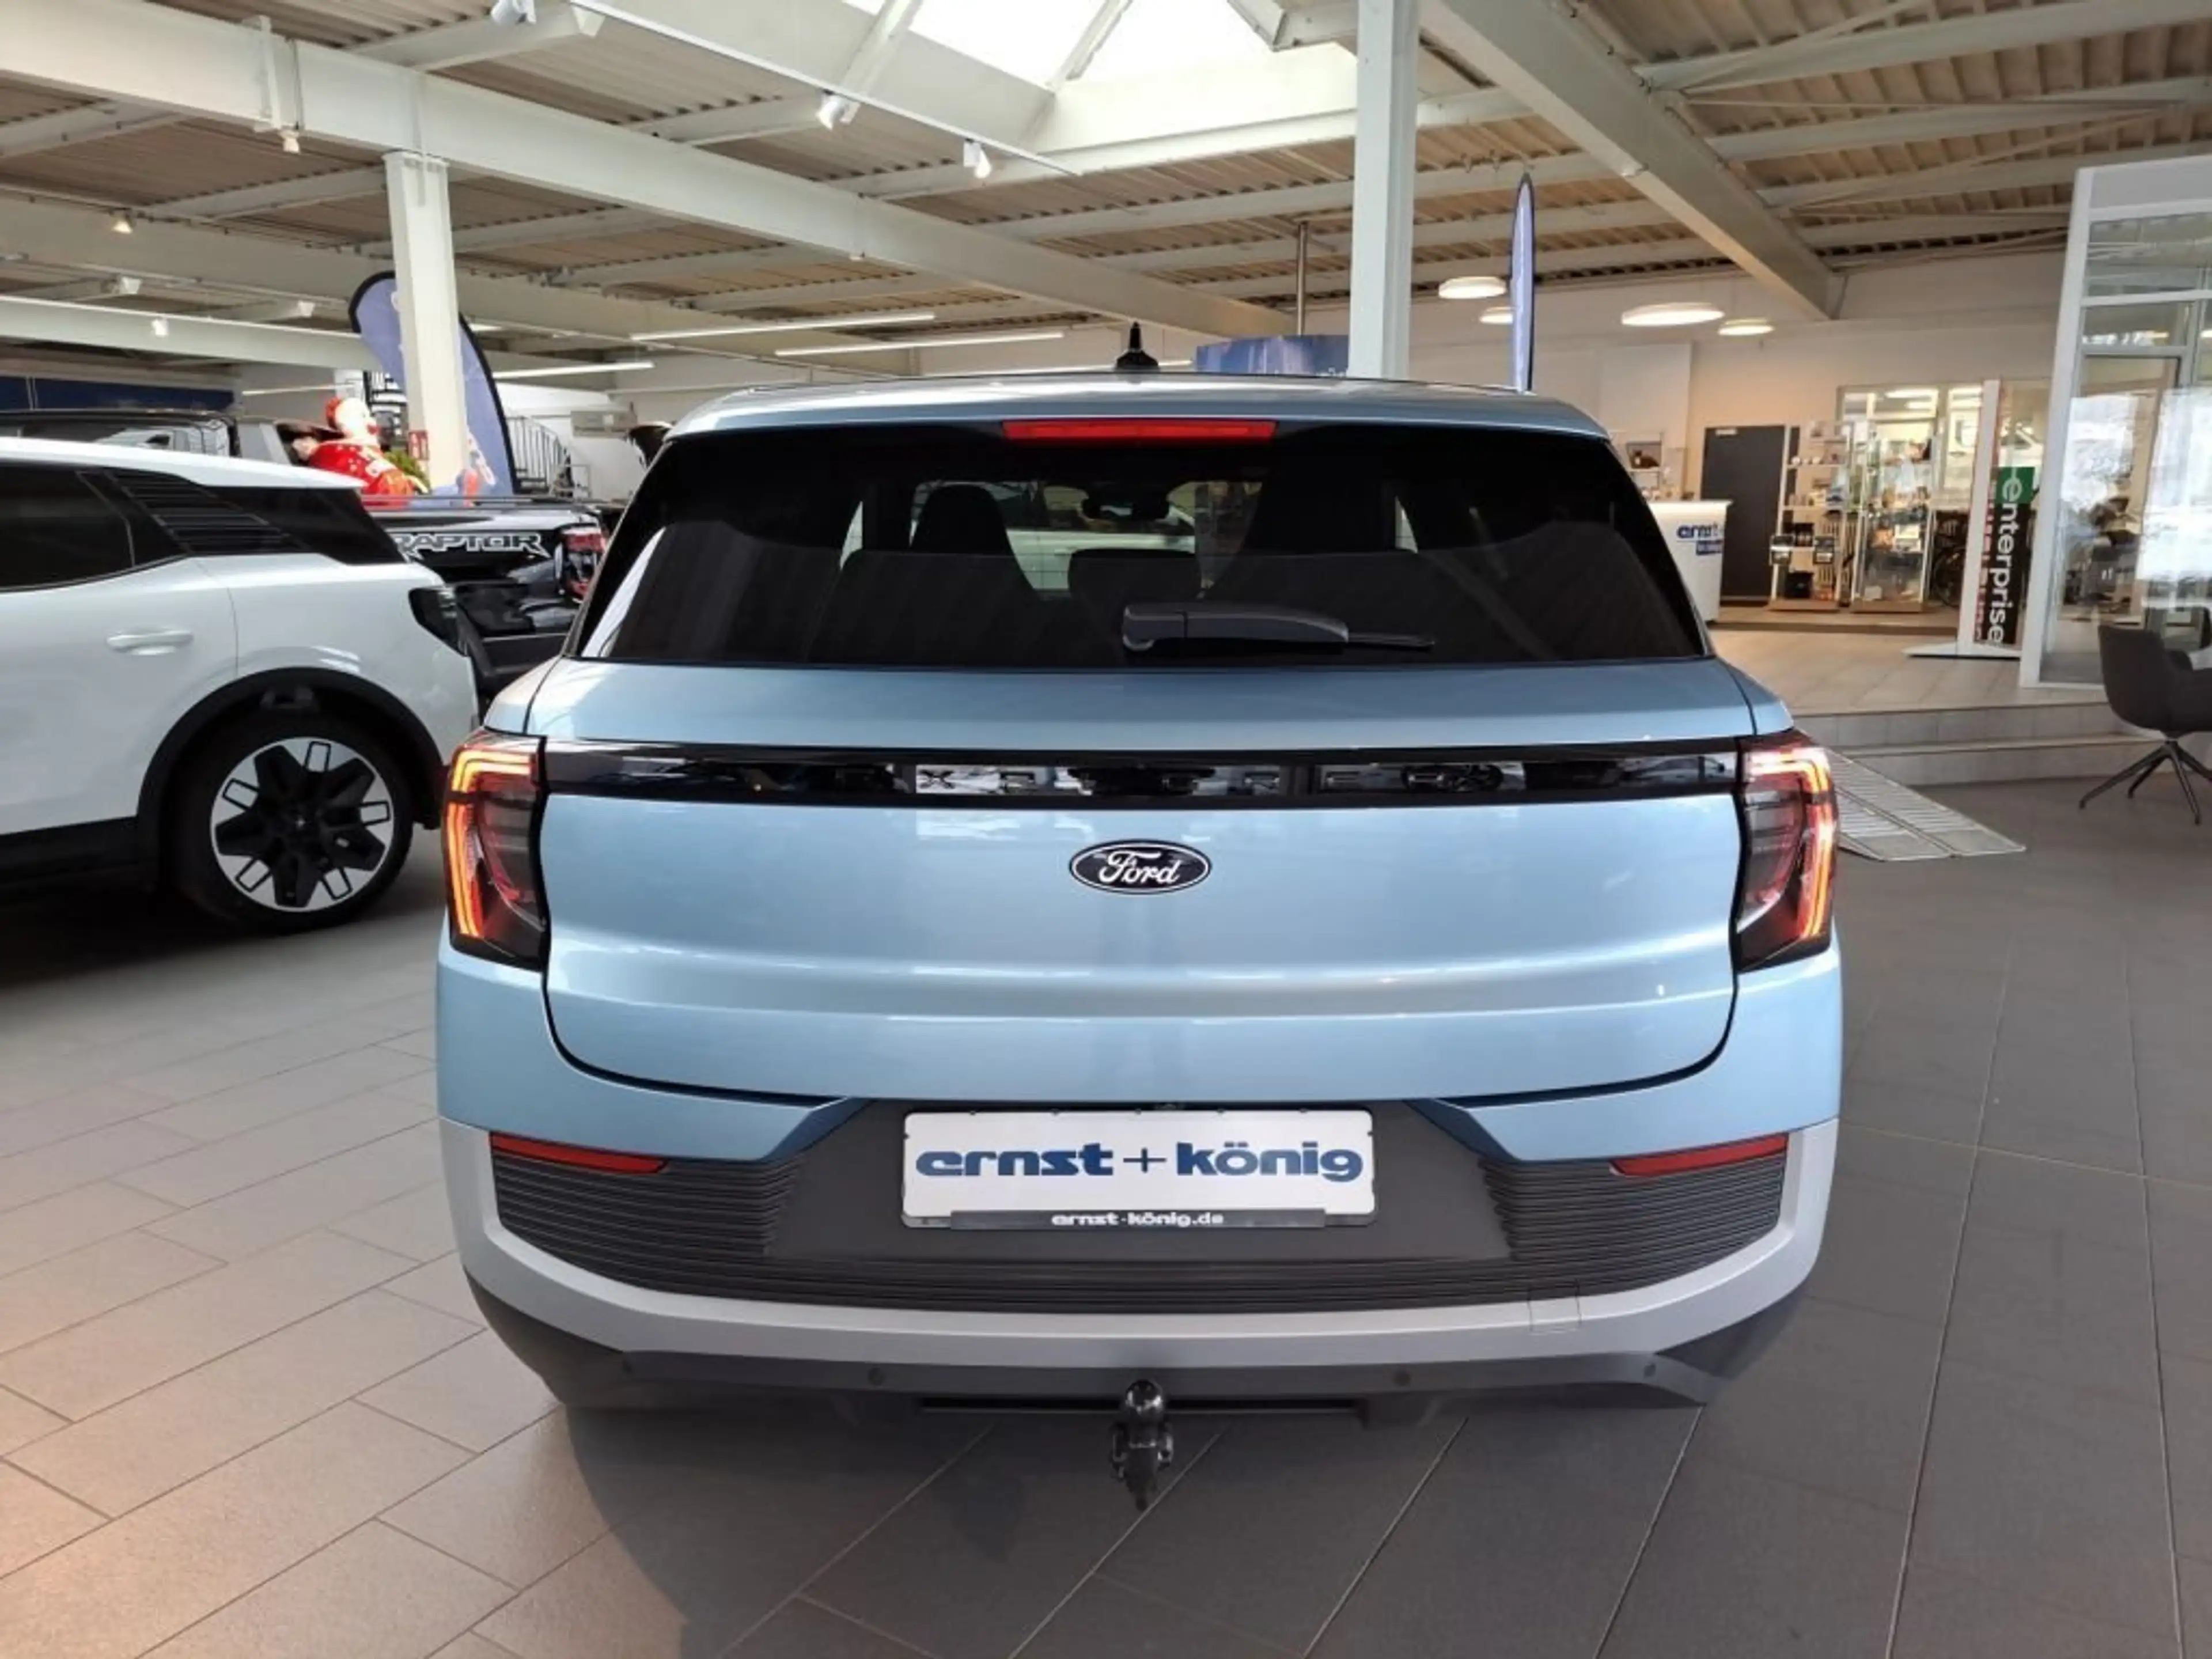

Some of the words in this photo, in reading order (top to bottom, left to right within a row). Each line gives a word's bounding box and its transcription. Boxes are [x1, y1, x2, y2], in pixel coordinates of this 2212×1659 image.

[1988, 476, 2023, 643] enterprise
[1099, 850, 1181, 884] Ford
[915, 1143, 1113, 1176] ernst
[1123, 1147, 1167, 1173] +
[1176, 1141, 1363, 1182] könig
[1051, 1212, 1224, 1228] ernst-könig.de
